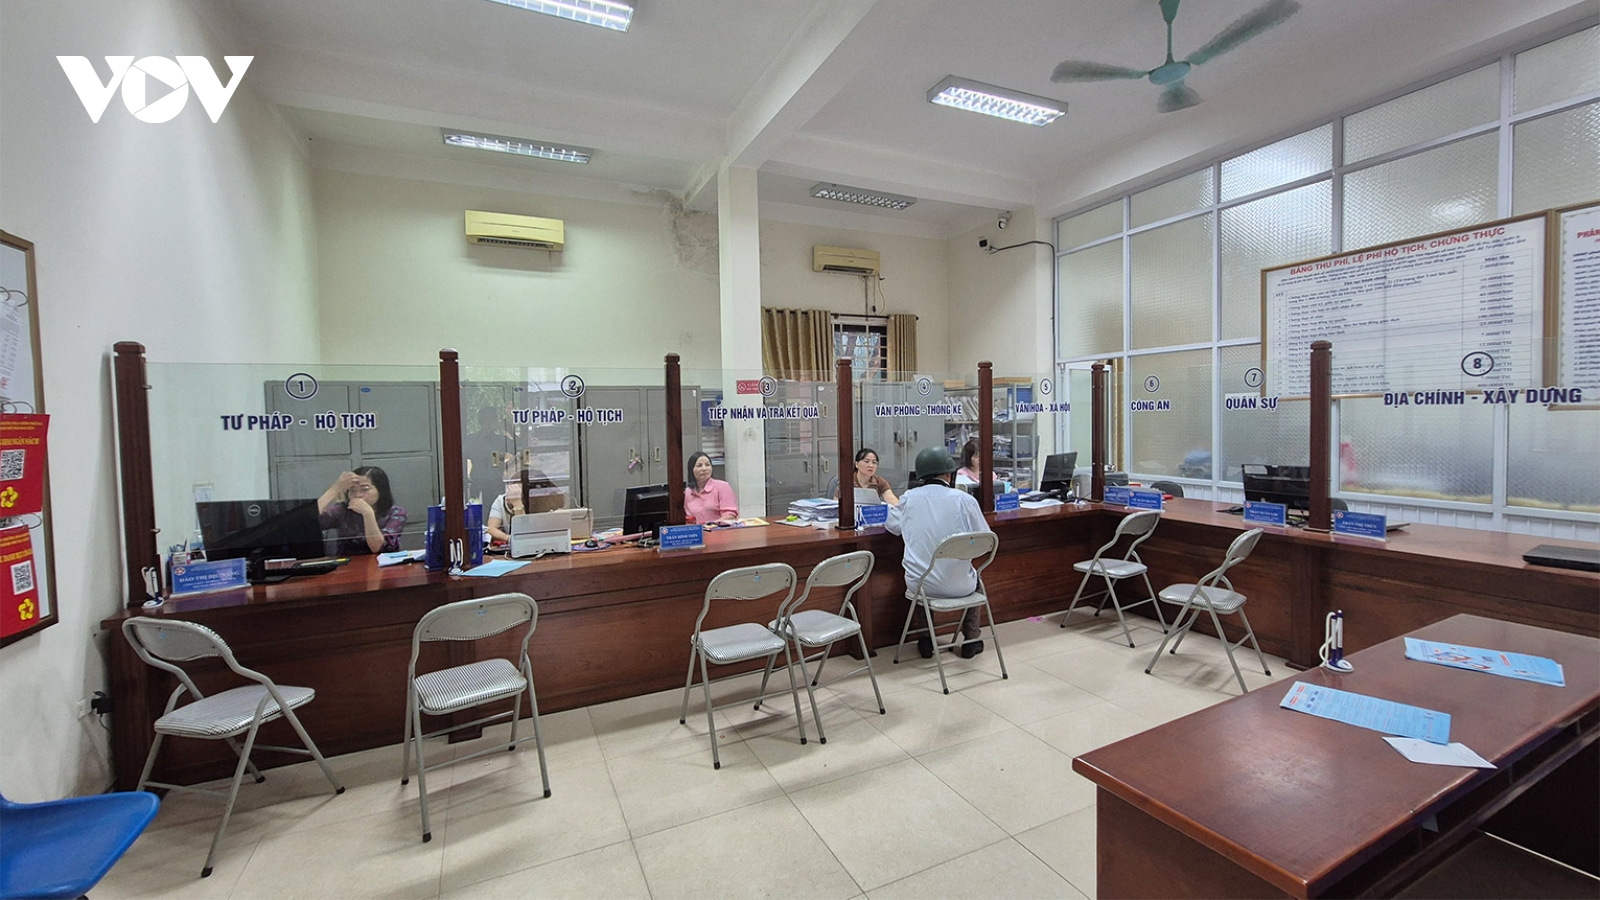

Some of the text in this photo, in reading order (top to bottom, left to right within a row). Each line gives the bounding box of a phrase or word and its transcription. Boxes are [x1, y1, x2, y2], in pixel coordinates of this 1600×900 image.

[1290, 264, 1314, 275] BẢNG
[1316, 261, 1332, 270] THU
[1352, 254, 1364, 264] LỆ
[1366, 250, 1382, 260] PHÍ
[1384, 248, 1398, 258] HỘ
[1430, 234, 1470, 249] CHỨNG
[1472, 227, 1506, 240] THỰC
[1473, 358, 1482, 369] 8
[1252, 373, 1258, 382] 7
[298, 380, 304, 392] 1
[570, 380, 576, 390] 2
[765, 382, 770, 392] 3
[1226, 395, 1278, 412] QUÂN SỰ
[1384, 392, 1409, 408] ĐỊA
[1414, 388, 1465, 404] CHÍNH
[1482, 386, 1520, 404] XÂY
[1526, 386, 1582, 406] DỰNG
[1130, 399, 1170, 410] CÔNG AN
[512, 408, 530, 424] TƯ
[532, 407, 565, 423] PHÁP
[578, 408, 593, 425] HỘ
[596, 409, 623, 425] TỊCH
[709, 404, 728, 420] TIẾP
[730, 405, 754, 422] NHẬN
[769, 402, 784, 418] TRẢ
[786, 402, 800, 418] KẾT
[803, 402, 819, 418] QUẢ
[220, 414, 244, 430] TƯ
[248, 411, 292, 430] PHÁP
[314, 411, 336, 432] HỘ
[340, 413, 376, 432] TỊCH
